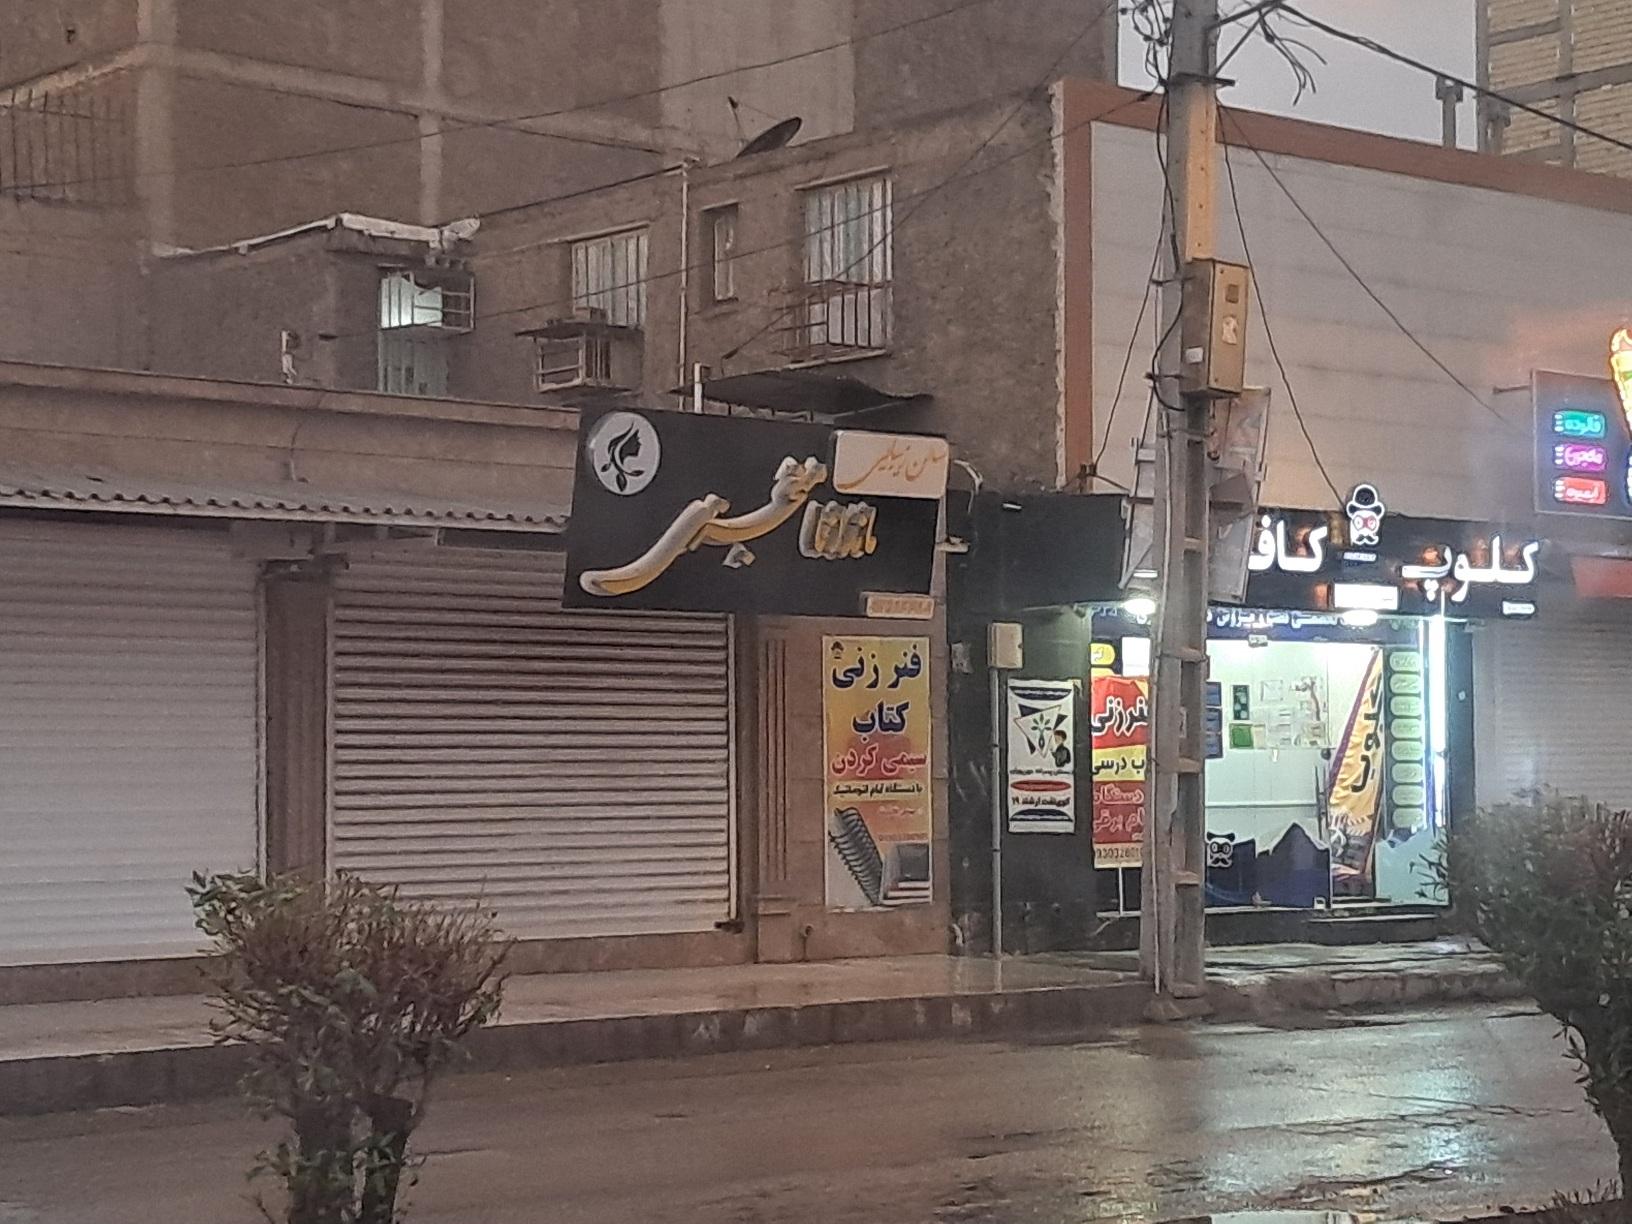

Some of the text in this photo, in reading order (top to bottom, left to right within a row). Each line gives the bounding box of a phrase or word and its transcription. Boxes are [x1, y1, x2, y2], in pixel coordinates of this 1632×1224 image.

[1248, 514, 1539, 602] کلوپ کاف
[832, 644, 922, 689] فنر زنی
[852, 700, 910, 742] کتاب
[1092, 696, 1148, 736] نرزنی
[831, 743, 928, 777] سیمی کردن
[1091, 756, 1127, 775] درسی
